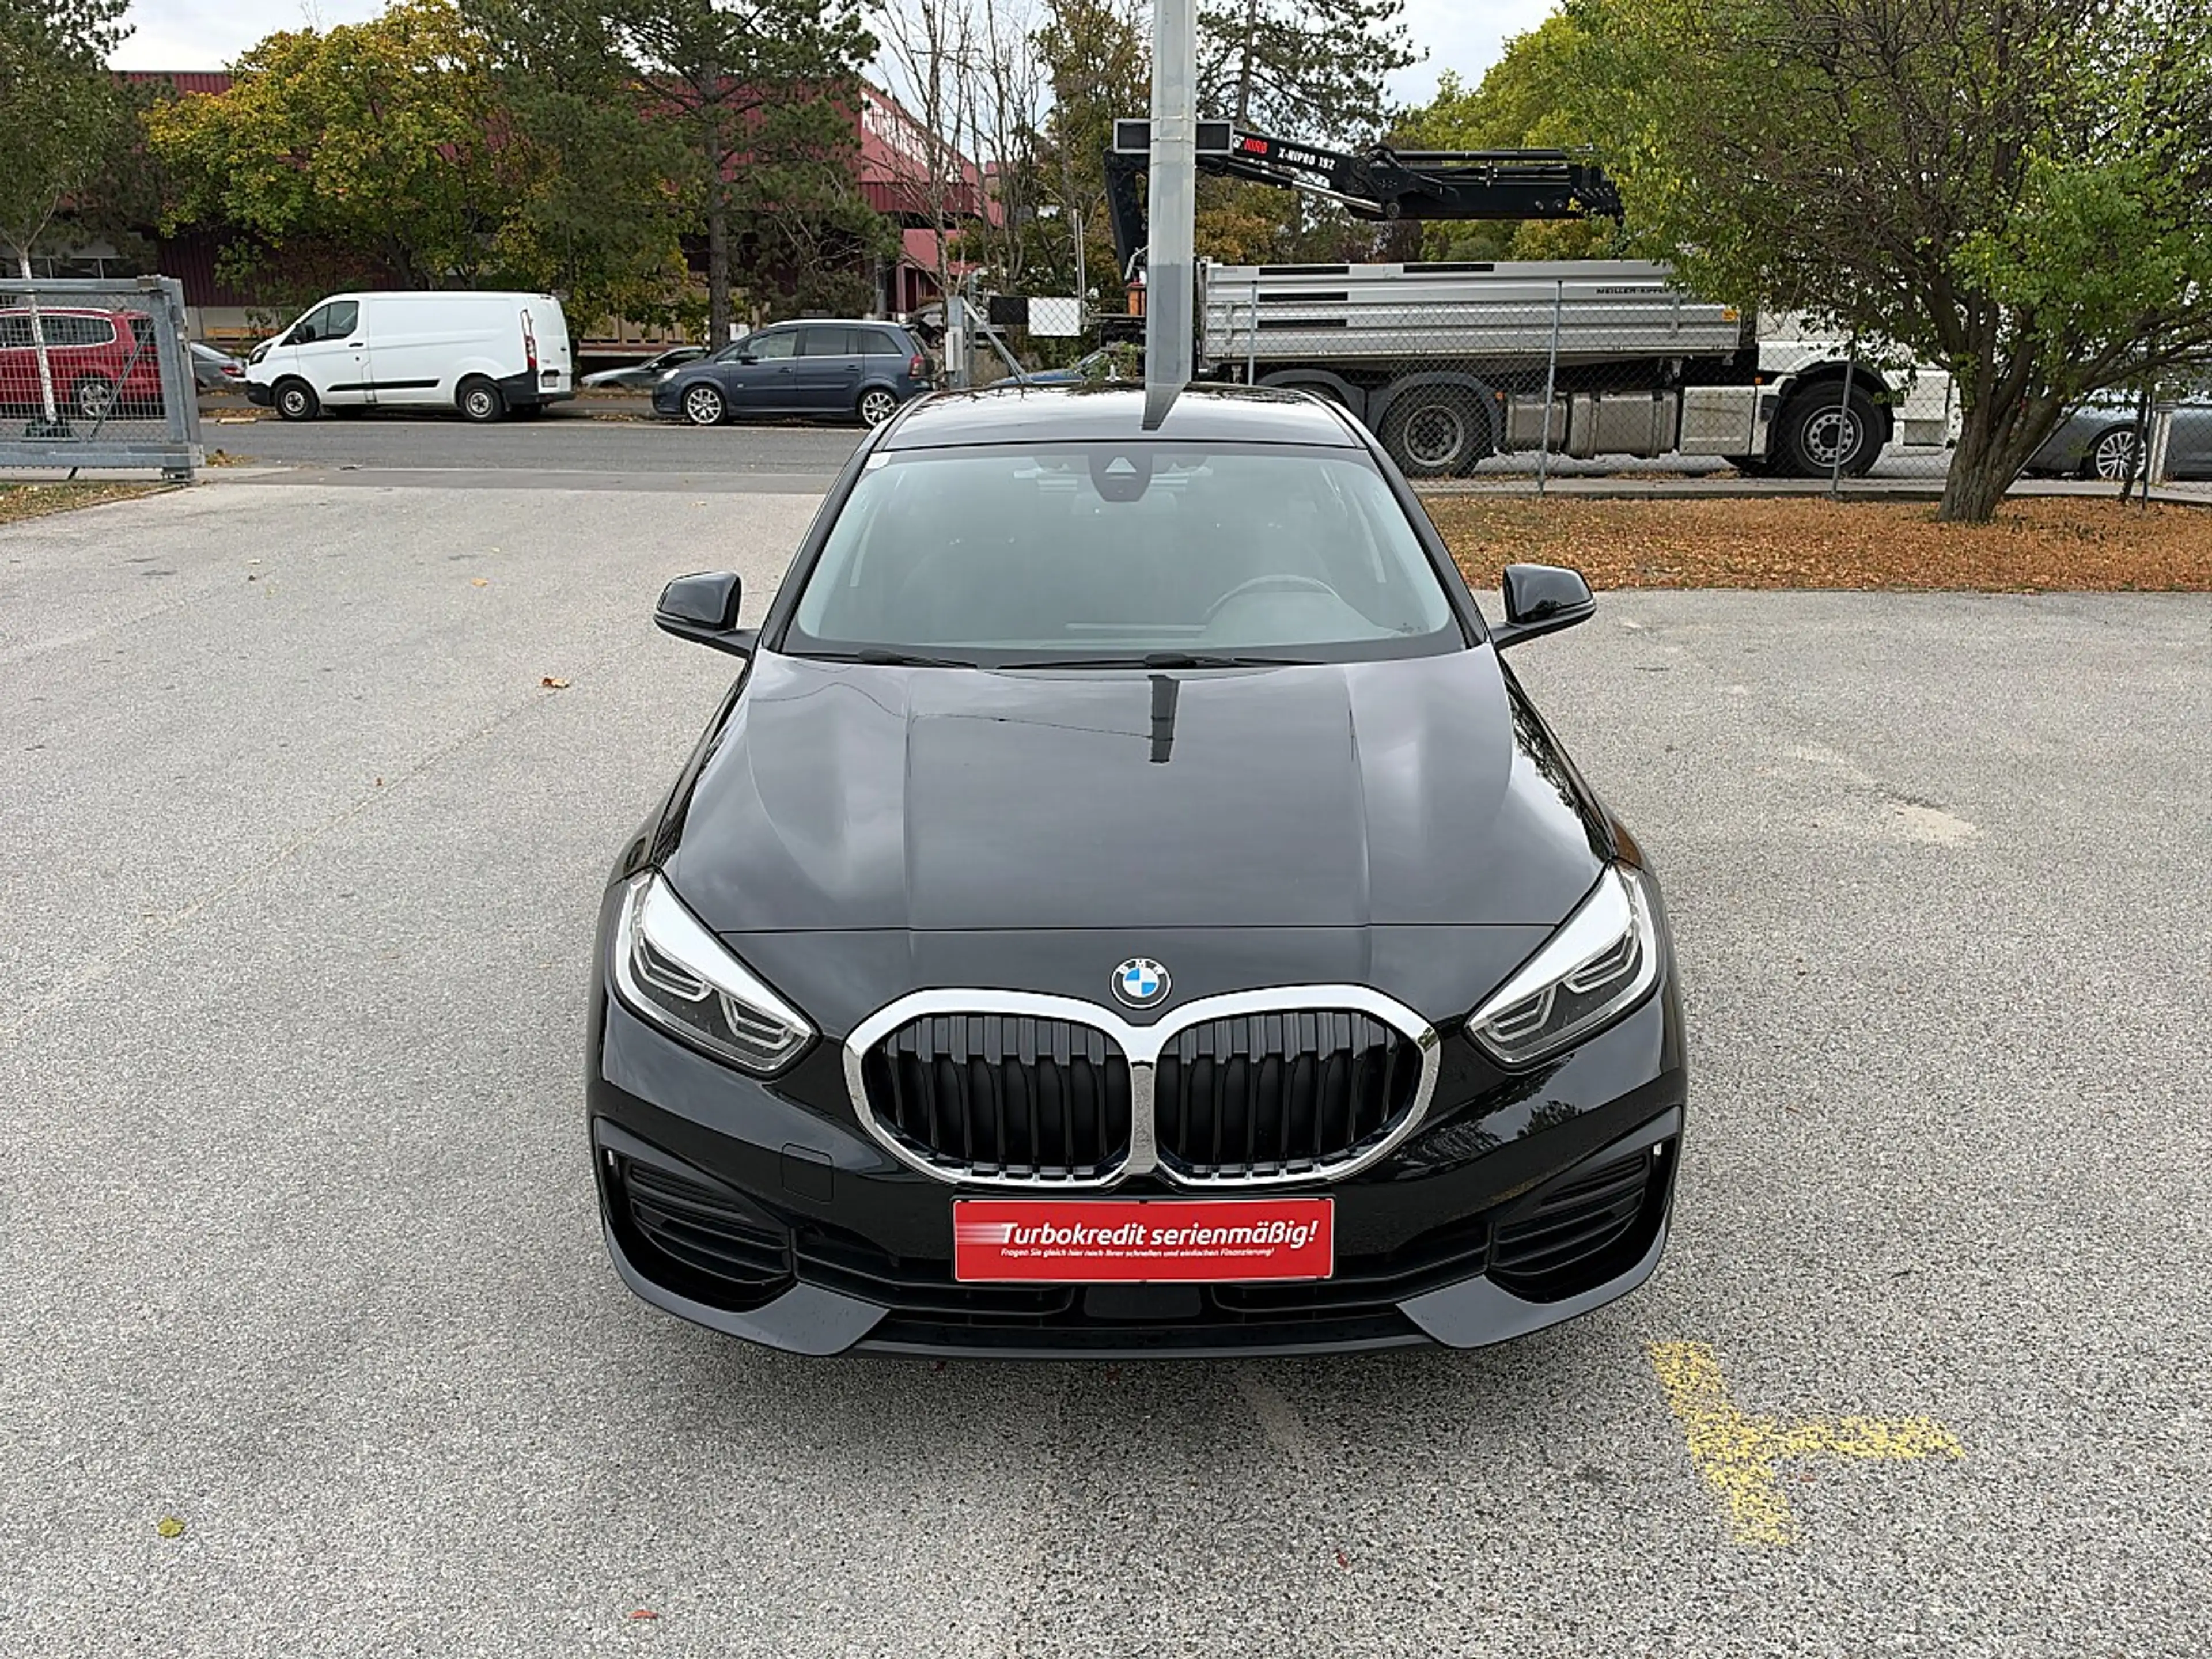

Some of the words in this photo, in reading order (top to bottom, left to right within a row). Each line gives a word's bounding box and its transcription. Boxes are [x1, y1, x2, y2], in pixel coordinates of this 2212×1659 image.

[1317, 156, 1335, 171] 192
[1001, 1222, 1147, 1245] Turbokredit
[1150, 1219, 1319, 1249] serienmäßig!
[1001, 1248, 1029, 1258] Fragen
[1030, 1248, 1042, 1256] Sie
[1043, 1249, 1066, 1258] gleich
[1067, 1249, 1083, 1257] hier
[1125, 1249, 1162, 1257] schnellen
[1180, 1249, 1219, 1257] einfachen
[1220, 1248, 1275, 1258] Finanzierung!
